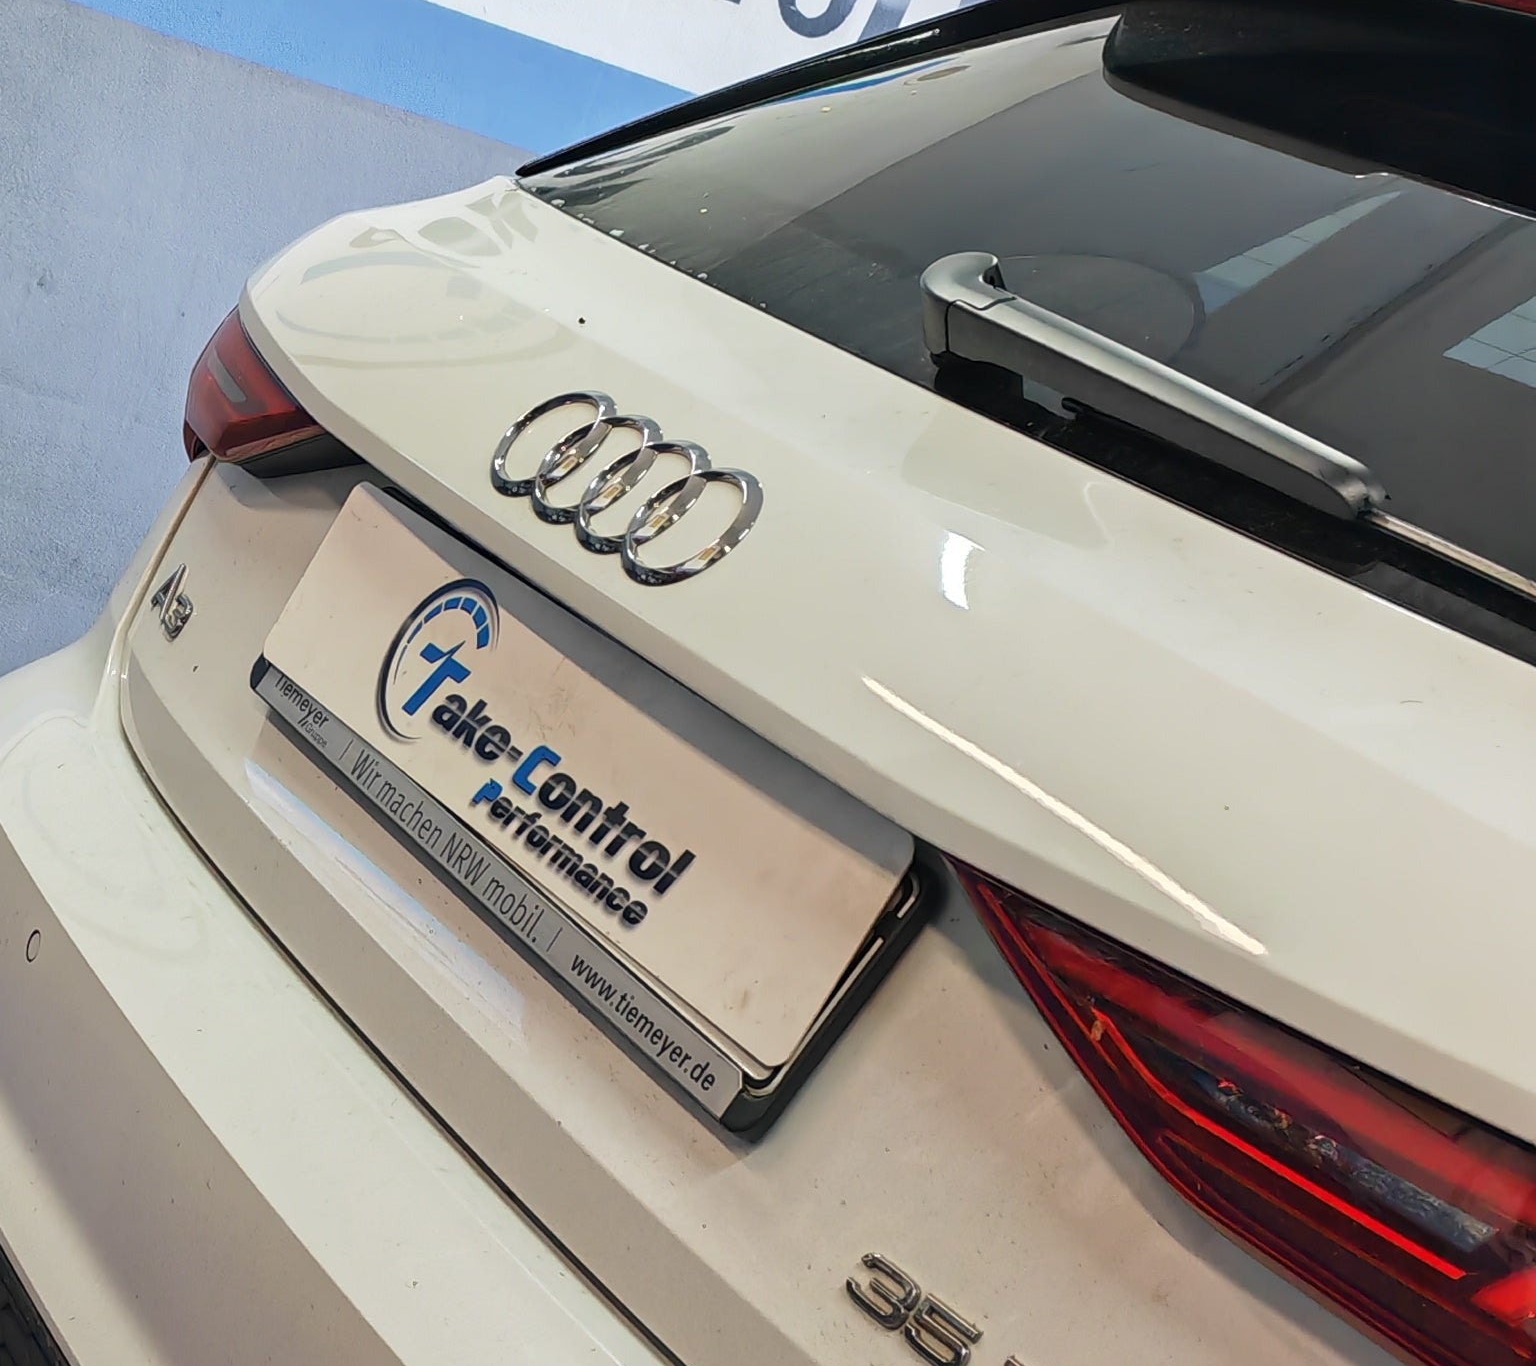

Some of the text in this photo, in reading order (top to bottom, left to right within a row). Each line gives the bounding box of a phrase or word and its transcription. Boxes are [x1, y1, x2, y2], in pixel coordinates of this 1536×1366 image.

[150, 563, 194, 640] A3
[402, 640, 696, 895] Take-Control
[350, 749, 545, 943] Wir machen NRW mobil.
[472, 777, 648, 926] Performance
[570, 954, 716, 1091] www.tiemeyer.de
